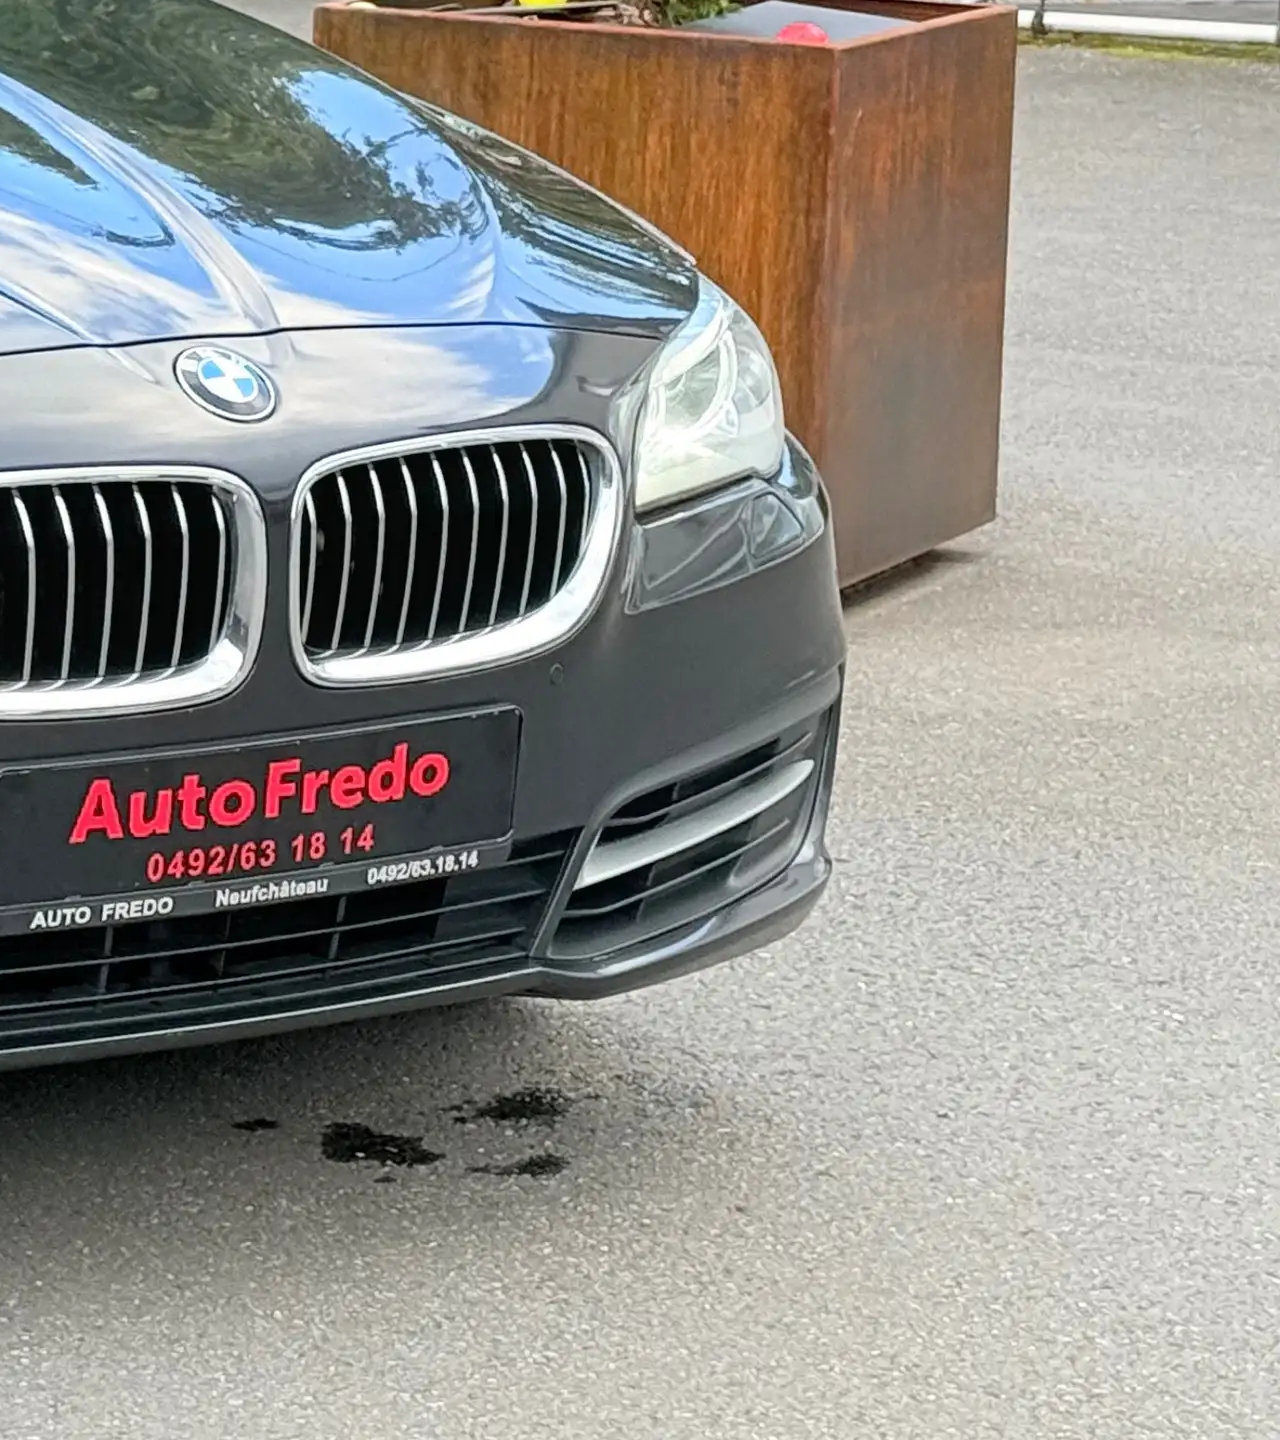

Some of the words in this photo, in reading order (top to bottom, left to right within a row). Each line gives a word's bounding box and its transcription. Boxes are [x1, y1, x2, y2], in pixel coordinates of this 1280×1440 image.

[146, 839, 277, 883] 0492/63
[290, 831, 327, 863] 18
[340, 822, 376, 855] 14
[28, 905, 92, 930] AUTO
[100, 895, 175, 921] FREDO
